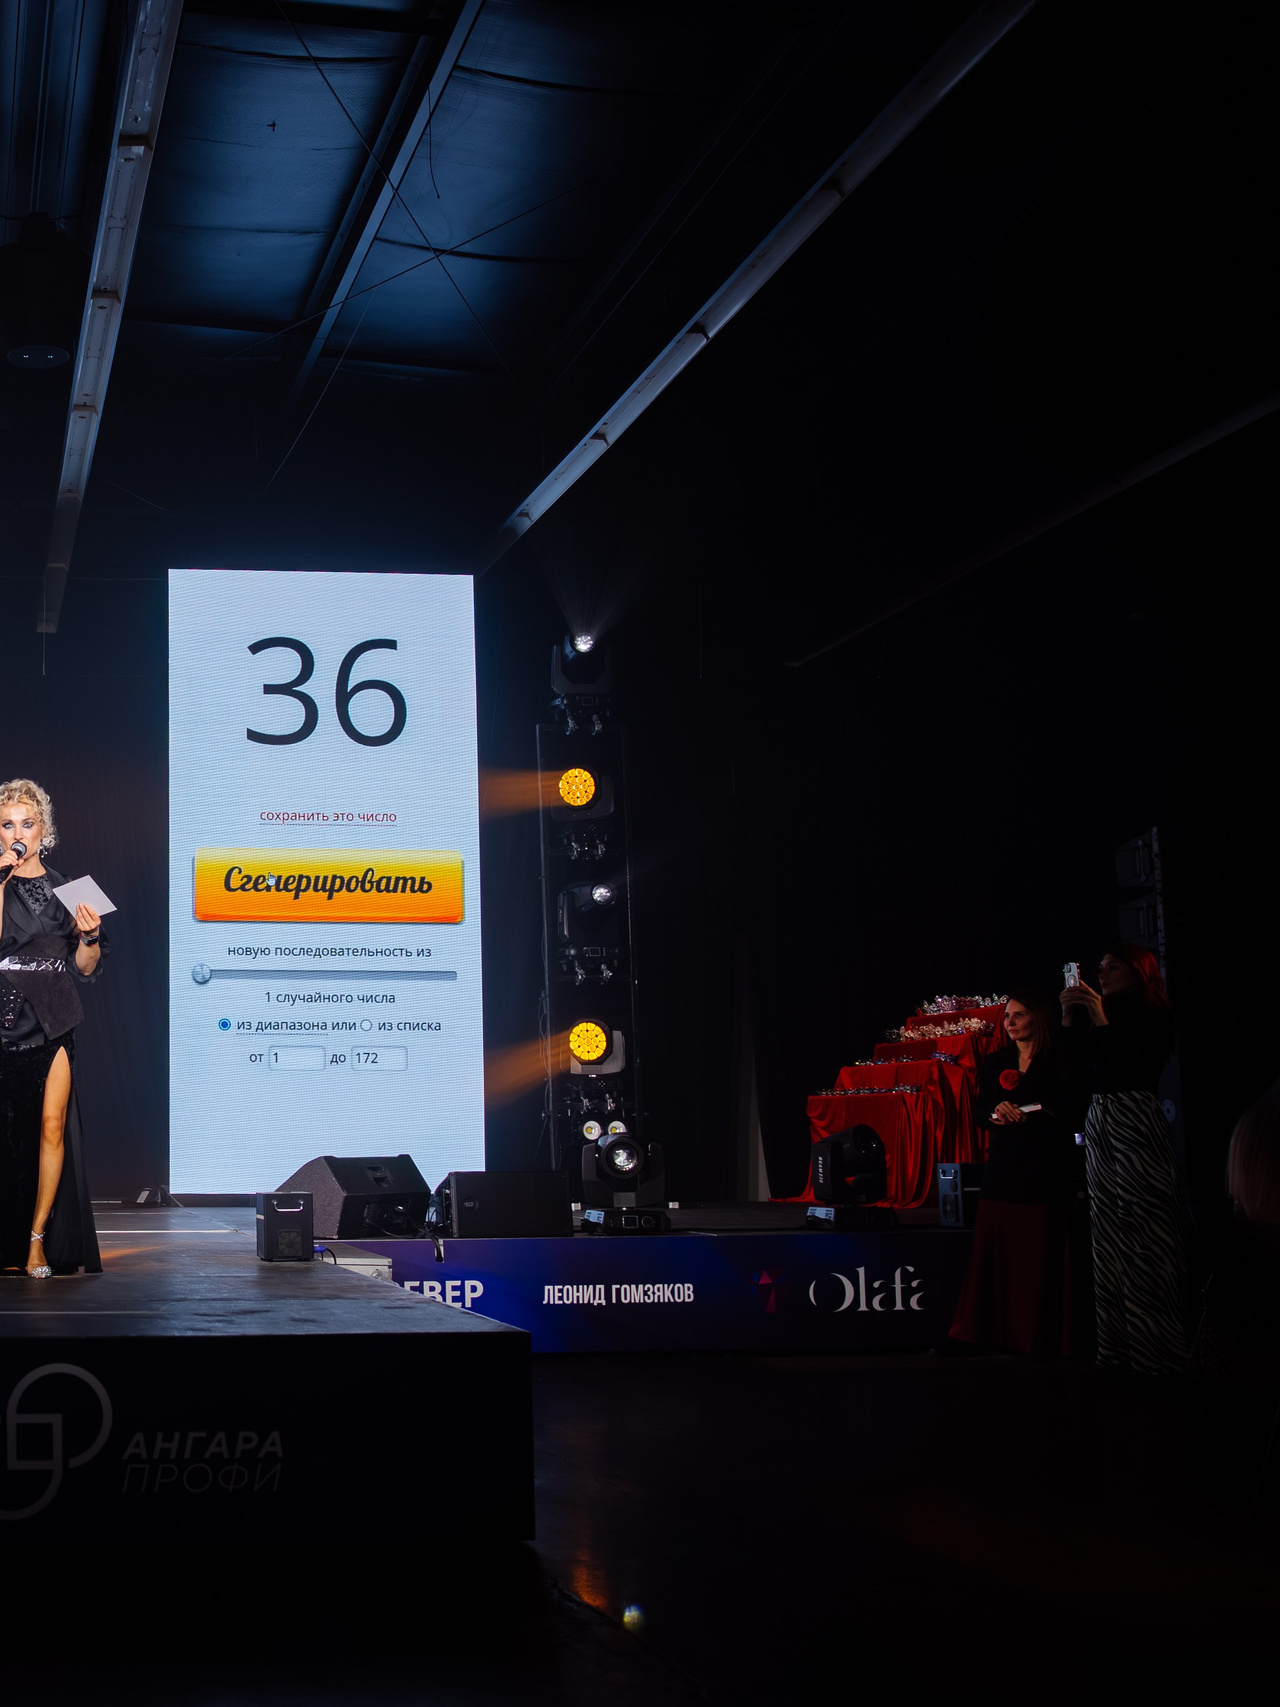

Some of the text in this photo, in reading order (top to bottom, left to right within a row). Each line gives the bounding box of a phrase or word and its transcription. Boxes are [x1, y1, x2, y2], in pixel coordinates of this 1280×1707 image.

[246, 636, 407, 747] 36
[259, 811, 397, 823] сохранить это число
[227, 946, 432, 960] новую последовательность из
[265, 991, 396, 1007] 1 случайного числа
[236, 1021, 442, 1032] из диапазона или из списка
[248, 1051, 379, 1065] от 1 до 172
[542, 1283, 695, 1306] ЛЕОНИД ГОМЗЯКОВ
[121, 1430, 285, 1461] АНГАРА
[121, 1461, 283, 1494] ПРОФИ
